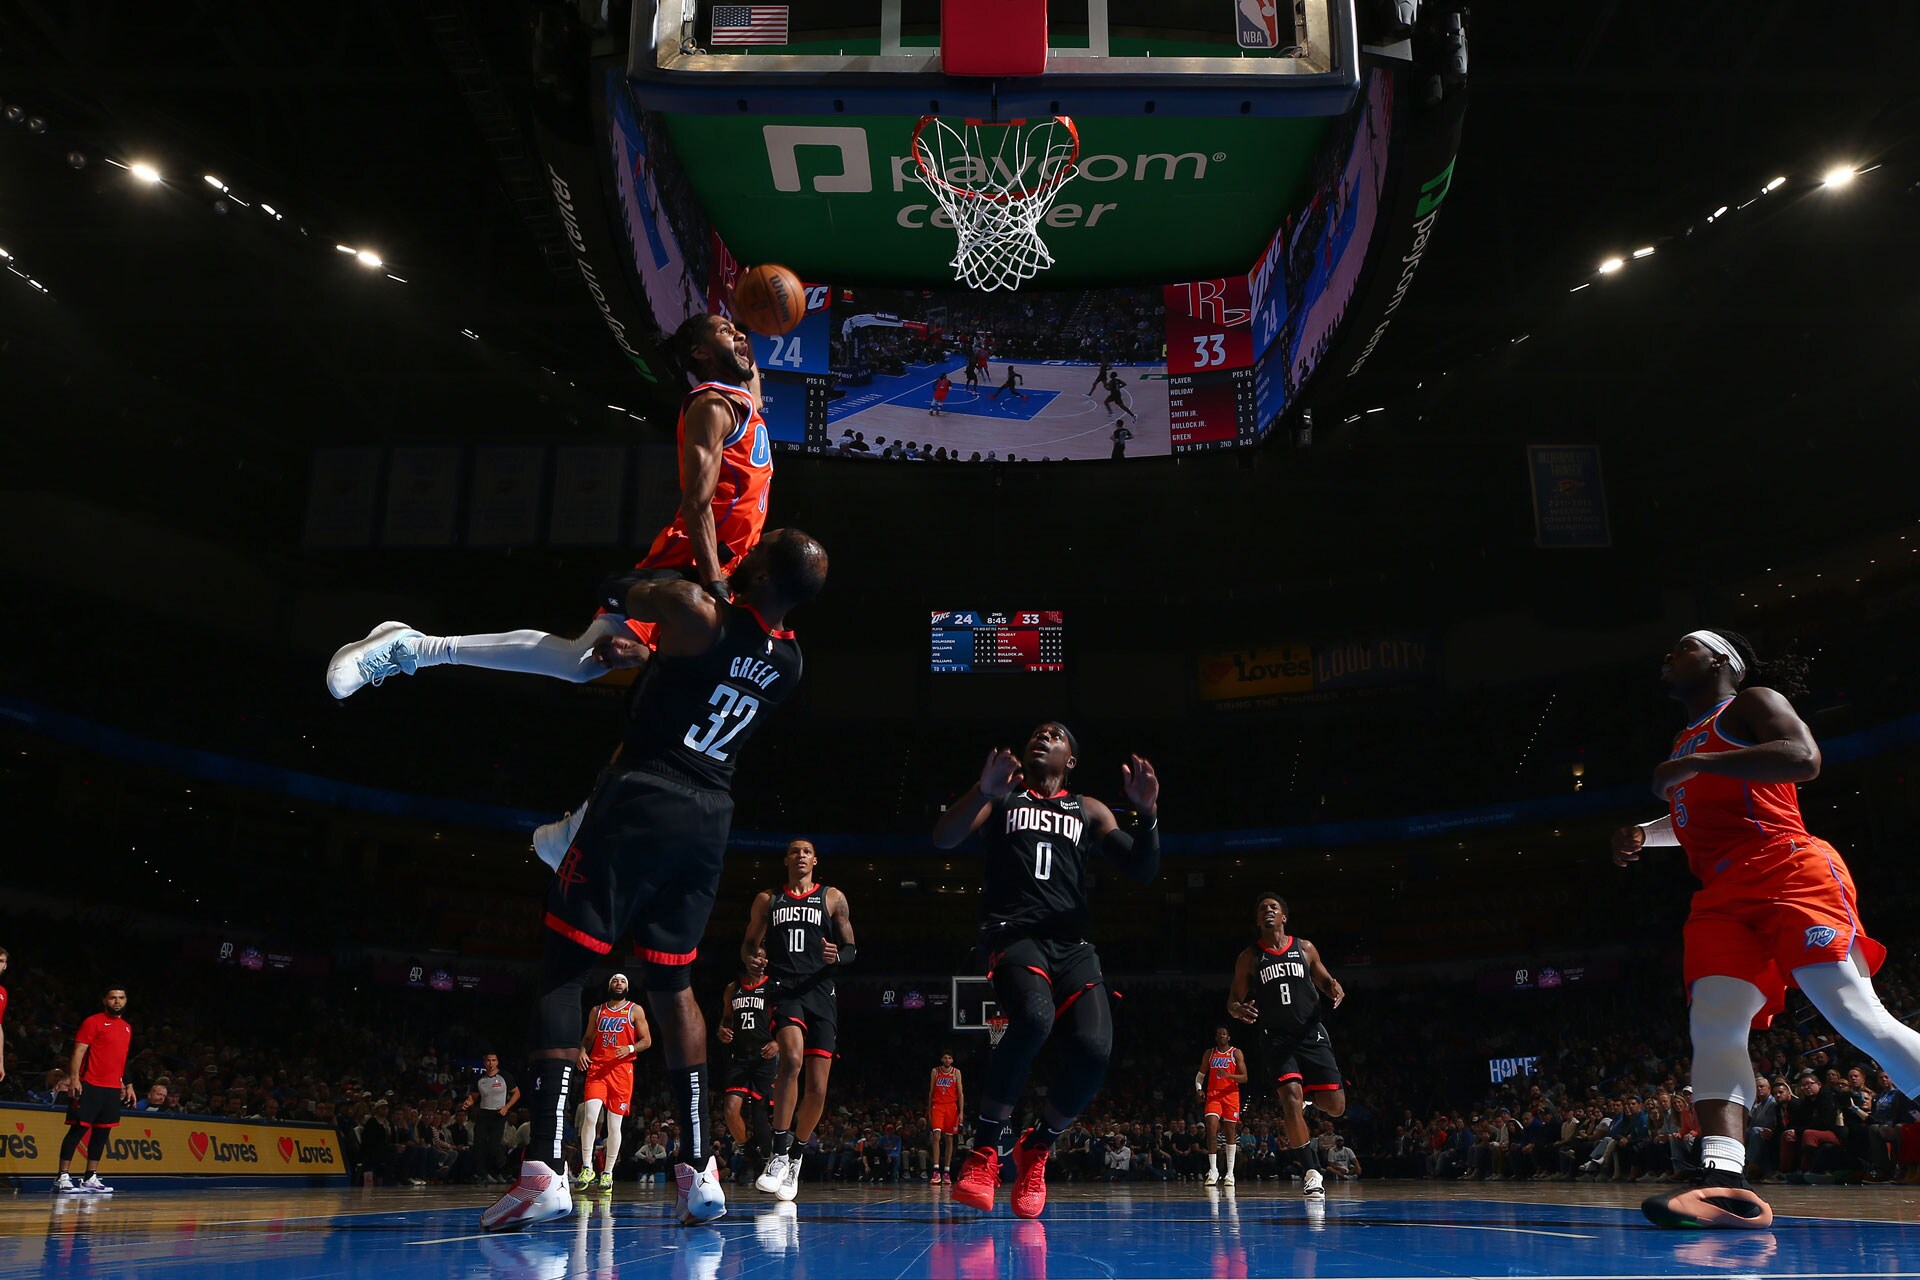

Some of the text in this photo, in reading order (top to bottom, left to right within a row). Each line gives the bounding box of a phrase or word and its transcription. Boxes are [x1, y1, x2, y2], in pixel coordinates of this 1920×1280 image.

[1243, 30, 1263, 44] NBA
[547, 163, 638, 355] paycom center
[1385, 209, 1438, 315] paycom
[1262, 298, 1277, 346] 24
[768, 335, 803, 369] 24
[1193, 333, 1227, 368] 33
[1172, 422, 1198, 430] BULLOCK
[931, 611, 950, 624] OKC
[954, 614, 973, 624] 24
[1022, 614, 1040, 624] 33
[1318, 640, 1428, 682] LOUD CITY
[730, 656, 780, 690] GREEN
[684, 683, 760, 762] 32
[1674, 786, 1689, 828] 5
[1006, 807, 1084, 847] HOUSTON
[1034, 841, 1052, 880] 0
[772, 906, 822, 926] HOUSTON
[788, 928, 805, 953] 10
[1807, 930, 1830, 946] OKC
[1260, 962, 1304, 984] HOUSTON
[732, 996, 764, 1011] HOUSTON
[1280, 983, 1292, 1005] 8
[598, 1016, 627, 1033] OKC
[741, 1012, 755, 1030] 25
[602, 1033, 617, 1048] 34
[1210, 1057, 1232, 1069] OKC
